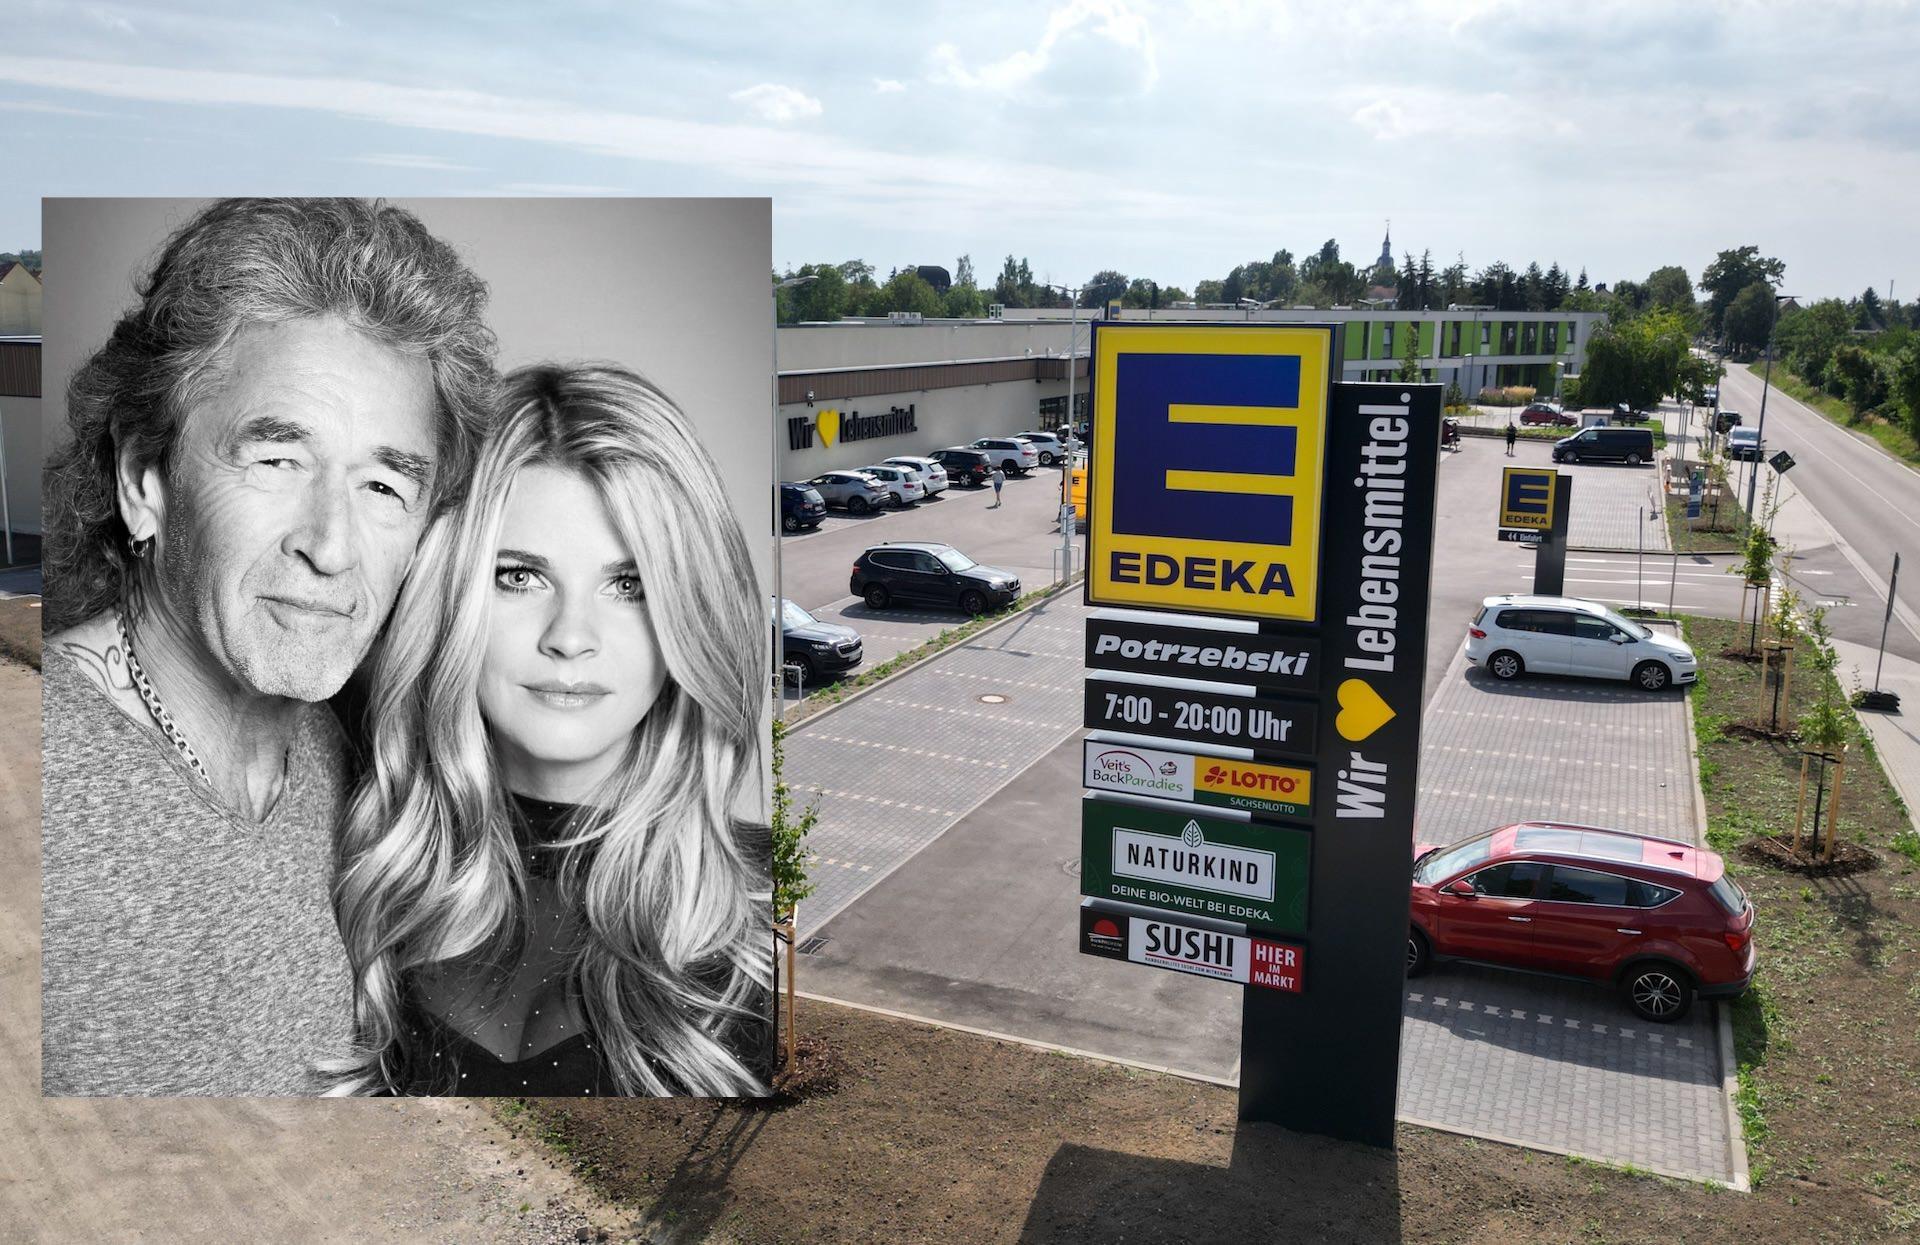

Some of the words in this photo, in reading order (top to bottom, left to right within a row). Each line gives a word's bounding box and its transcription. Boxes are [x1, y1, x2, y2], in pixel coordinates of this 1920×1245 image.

[788, 416, 816, 450] Wir
[839, 404, 918, 443] Lebensmittel.
[1112, 353, 1301, 546] E
[1344, 392, 1411, 672] Lebensmittel.
[1506, 515, 1547, 525] EDEKA
[1110, 551, 1295, 597] EDEKA
[1095, 634, 1310, 676] Potrzebski
[1105, 693, 1153, 725] 7:00
[1174, 701, 1242, 737] 20:00
[1248, 709, 1292, 742] Uhr
[1093, 769, 1183, 793] BackParadies
[1100, 757, 1131, 773] Veit's
[1231, 769, 1296, 793] LOTTO
[1336, 751, 1387, 818] Wir
[1230, 797, 1295, 814] SACHSENLOTTO
[1128, 843, 1258, 885] NATURKIND
[1111, 884, 1147, 899] DEINE
[1149, 890, 1204, 910] BIO-WELT
[1207, 902, 1226, 914] BEI
[1229, 905, 1274, 922] EDEKA.
[1145, 923, 1233, 967] SUSHI
[1255, 944, 1295, 967] HIER
[1254, 972, 1295, 989] MARKT
[1269, 964, 1280, 974] IM
